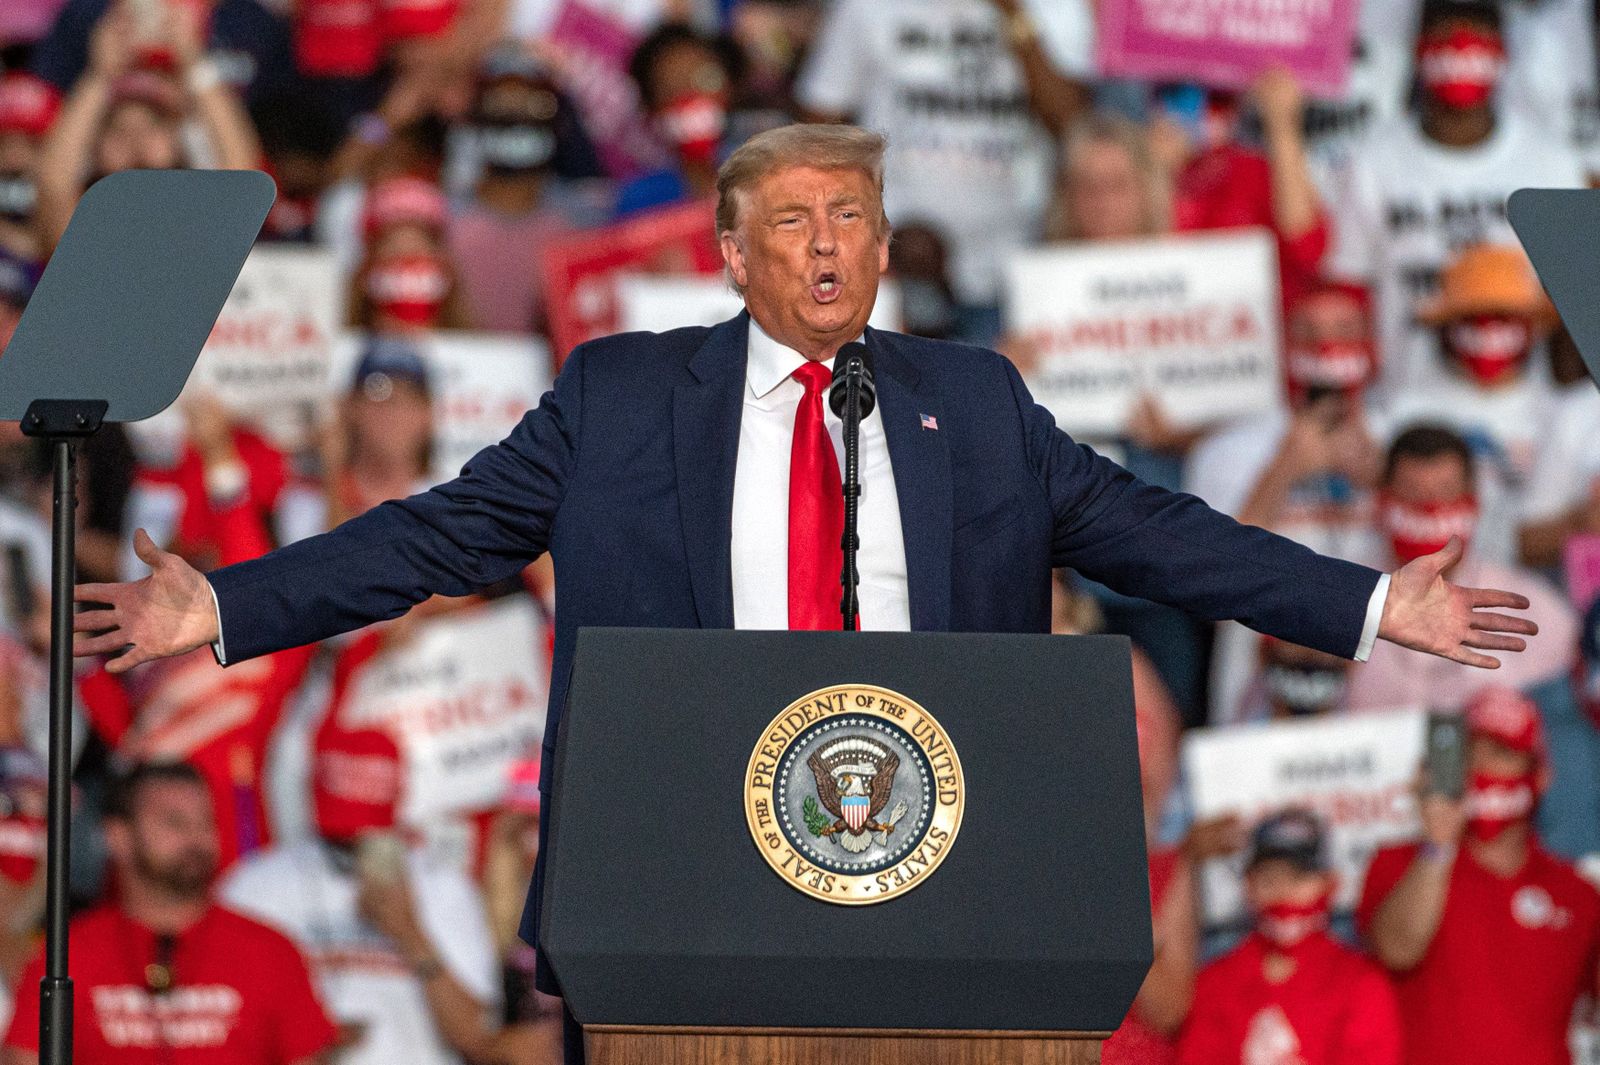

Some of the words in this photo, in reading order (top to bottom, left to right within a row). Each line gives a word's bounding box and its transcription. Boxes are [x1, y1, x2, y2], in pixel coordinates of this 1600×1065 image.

[855, 694, 876, 708] OF
[879, 698, 907, 720] THE
[752, 692, 848, 790] PRESIDENT
[911, 716, 957, 806] UNITED
[756, 798, 772, 828] THE
[764, 832, 781, 849] OF
[780, 849, 836, 893] SEAL
[875, 826, 949, 893] STATES
